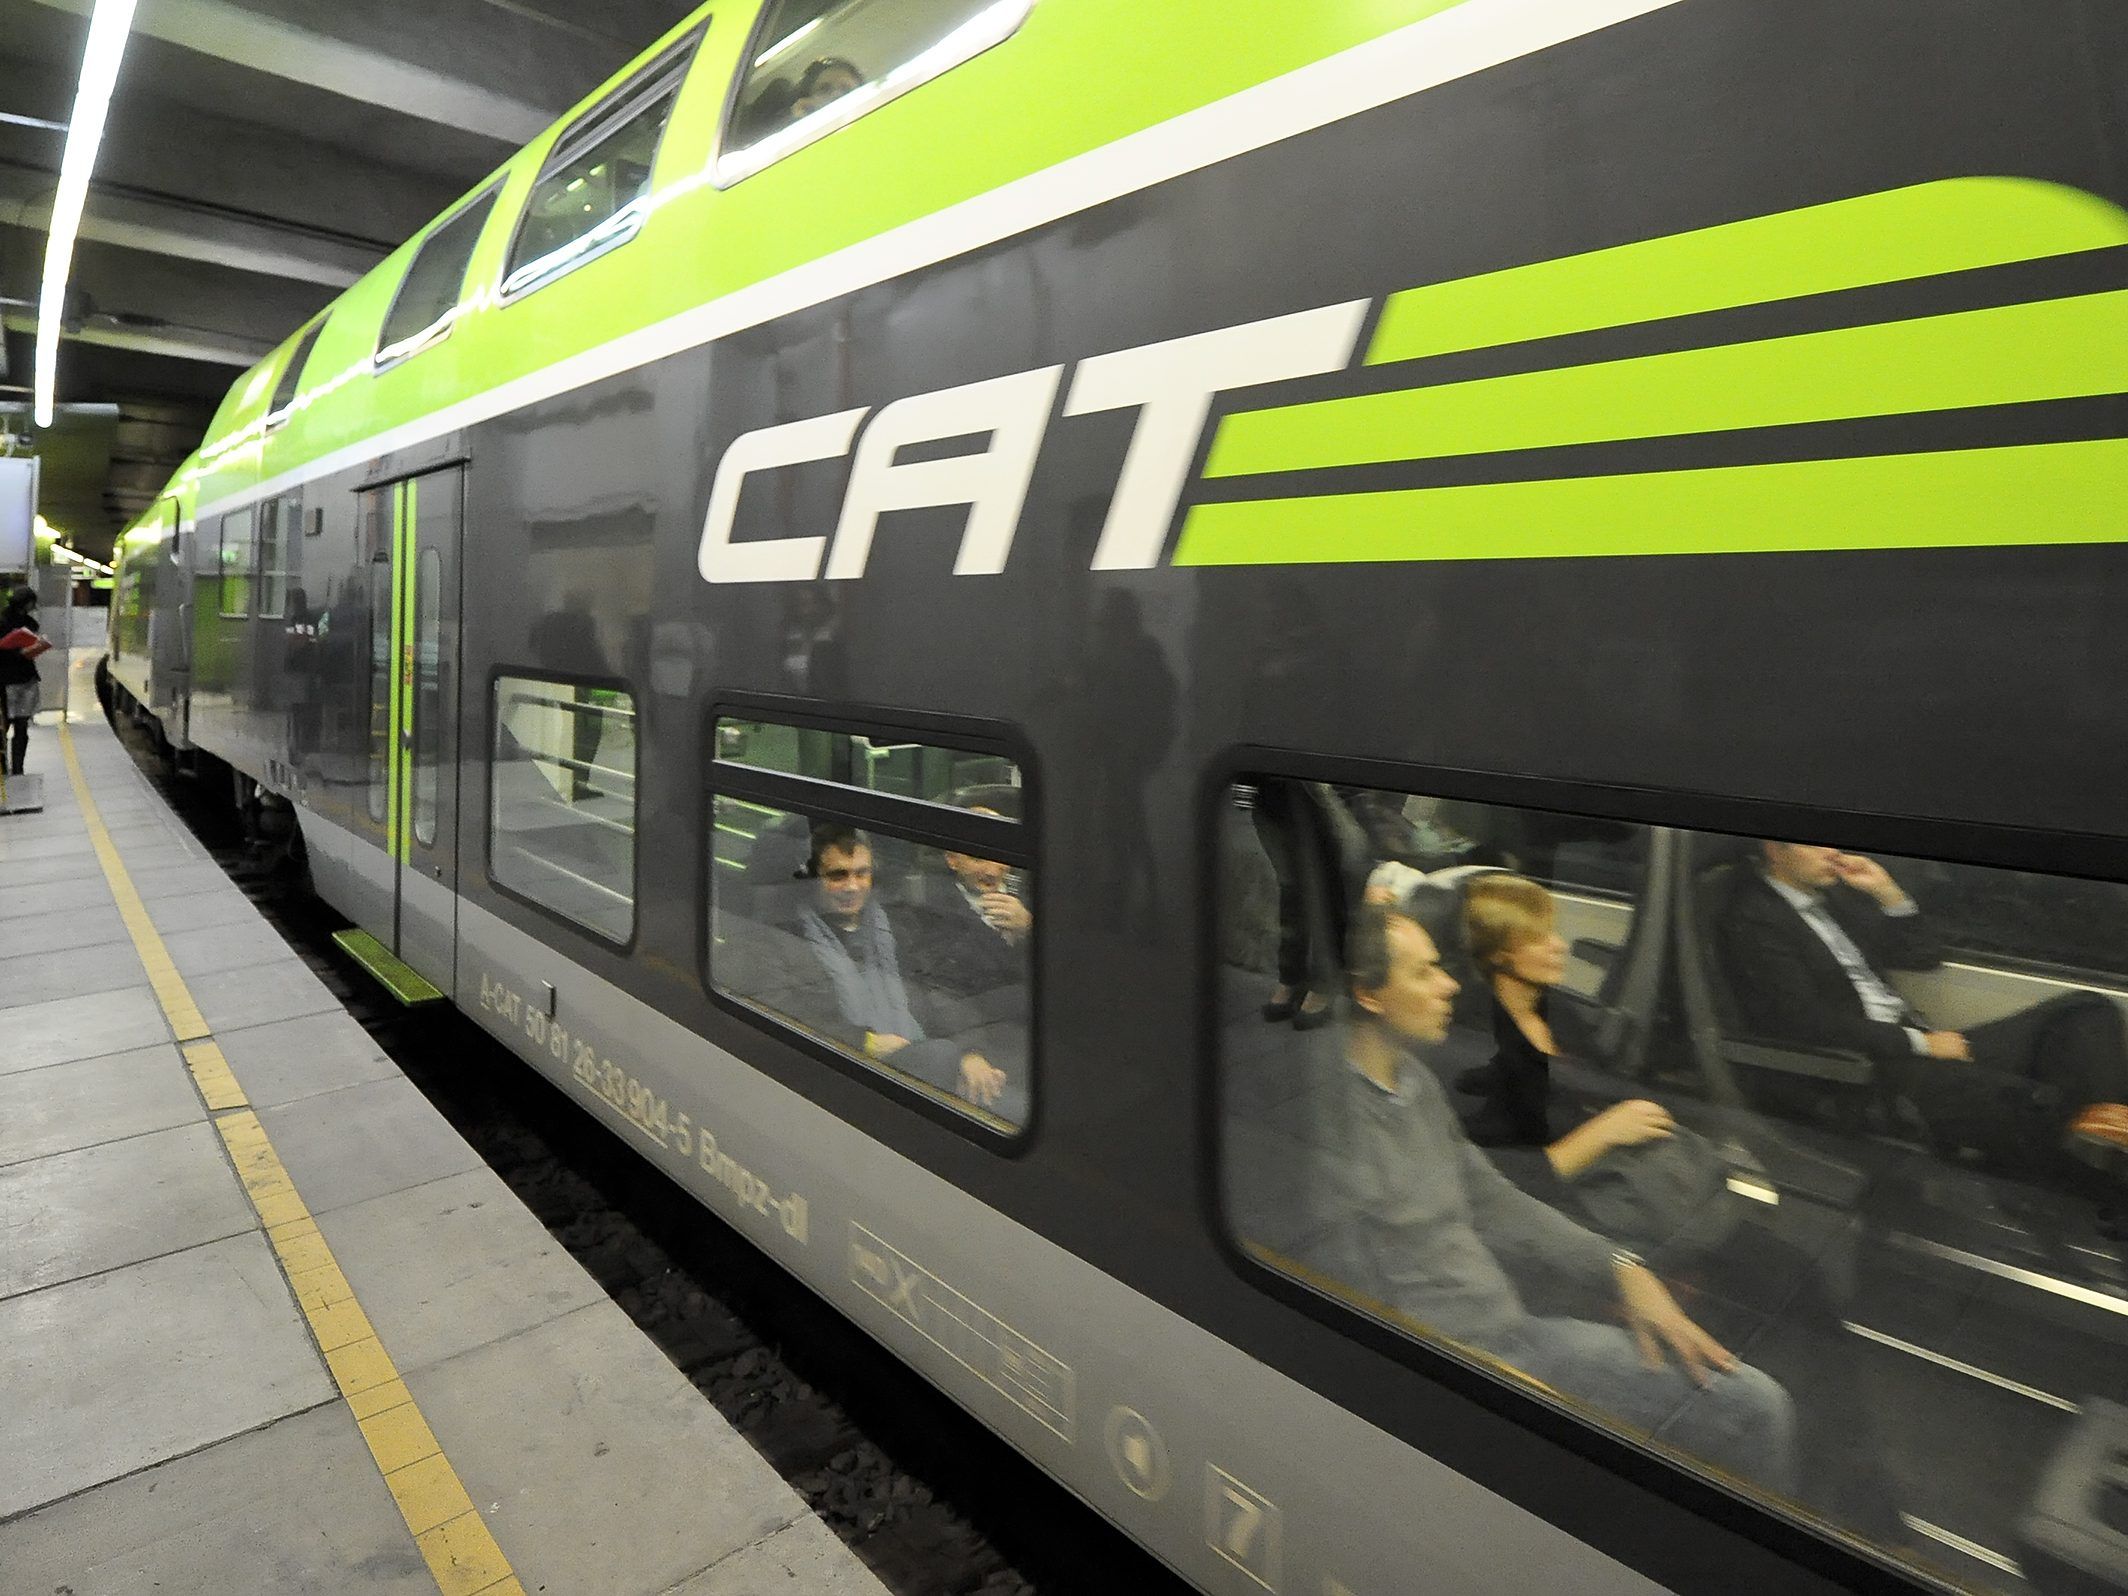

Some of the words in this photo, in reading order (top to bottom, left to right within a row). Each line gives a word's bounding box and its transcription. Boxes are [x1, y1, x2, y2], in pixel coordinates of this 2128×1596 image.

[698, 297, 1372, 583] CAT
[480, 972, 522, 1026] A-CAT
[525, 1004, 547, 1046] 50
[549, 1022, 569, 1064] 81
[1222, 1485, 1263, 1559] 7
